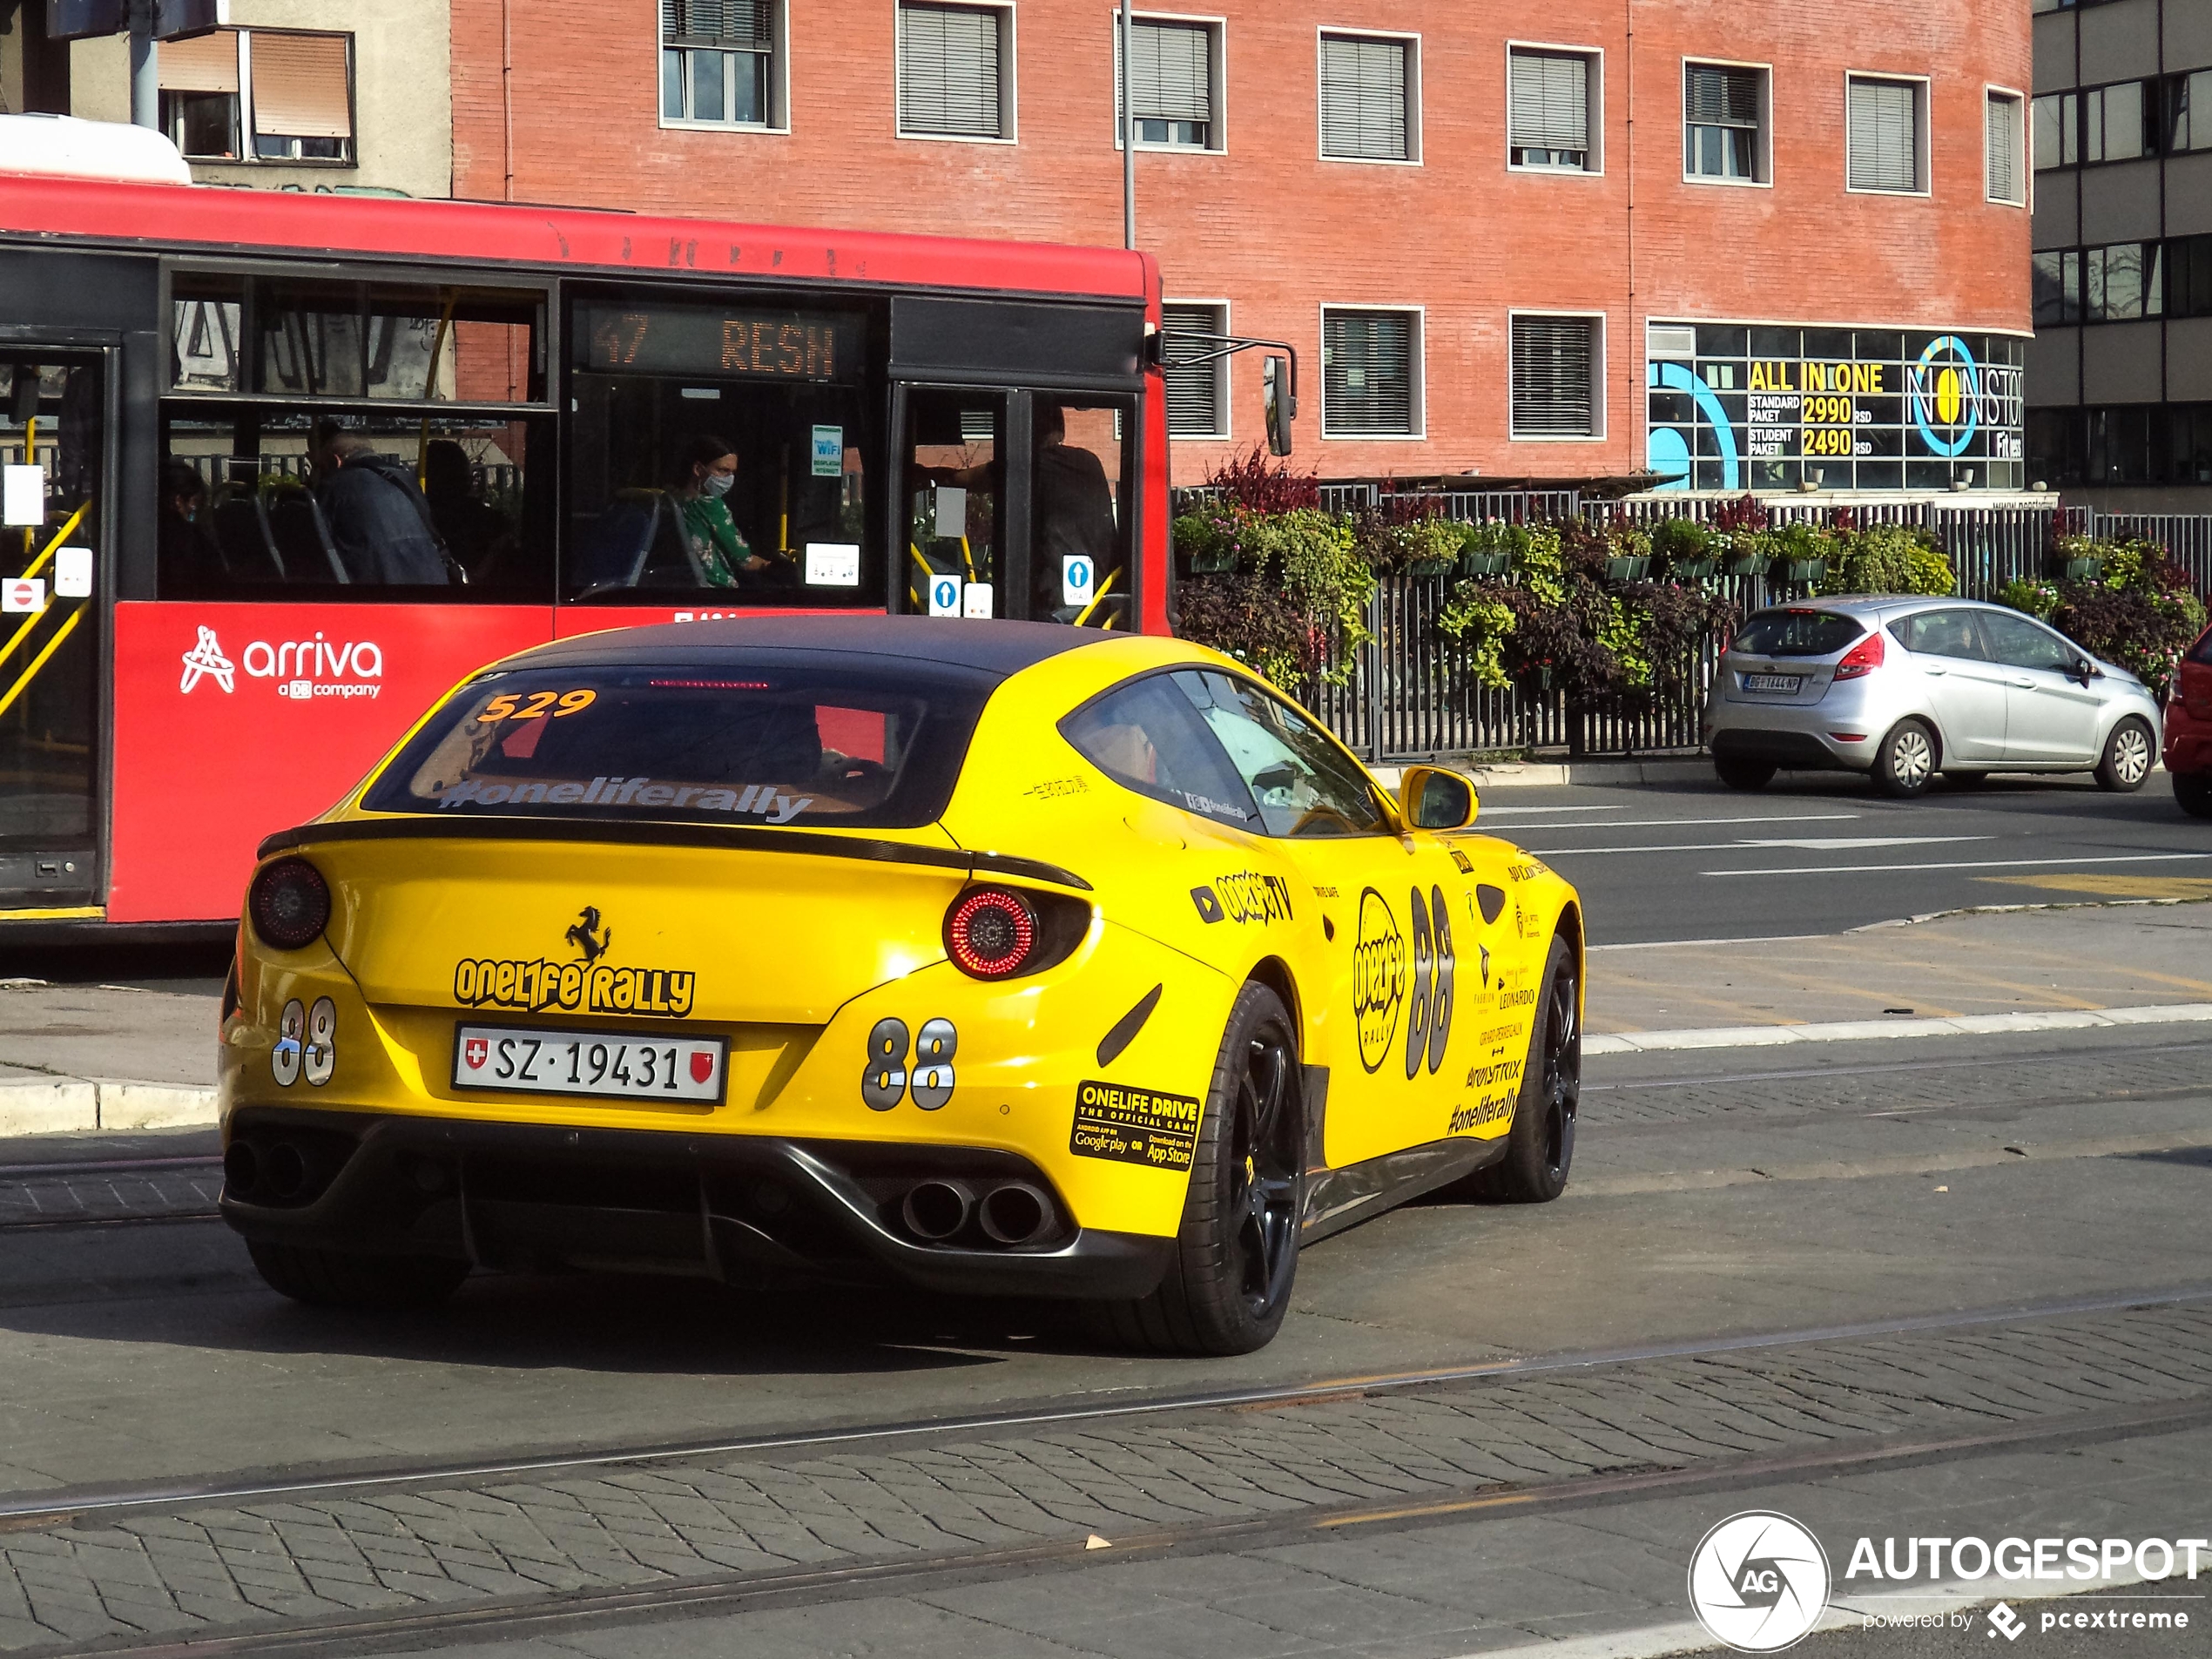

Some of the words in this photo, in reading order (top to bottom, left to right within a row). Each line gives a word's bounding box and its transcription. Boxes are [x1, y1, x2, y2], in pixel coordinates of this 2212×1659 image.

[593, 314, 649, 363] 47
[1750, 361, 1794, 391] ALL
[1803, 361, 1826, 392] IN
[1835, 363, 1884, 393] ONE
[1750, 395, 1800, 409] STANDARD
[1804, 396, 1851, 423] 2990
[1750, 409, 1780, 422] PAKET
[1855, 410, 1872, 423] RSD
[1750, 428, 1793, 442] STUDENT
[1804, 429, 1851, 455] 2490
[1750, 442, 1780, 455] PAKET
[1855, 442, 1872, 455] RSD
[242, 631, 383, 678] arriva
[278, 684, 289, 696] a
[291, 682, 311, 698] DB
[313, 684, 381, 699] company
[476, 688, 597, 723] 529
[438, 777, 813, 823] #oneliferally
[1406, 884, 1455, 1081] 88
[1499, 988, 1535, 1010] LEONARDO
[271, 995, 337, 1088] 88
[1363, 1022, 1393, 1048] RALLY
[860, 1016, 959, 1112] 88
[1082, 1087, 1150, 1114] ONELIFE
[1151, 1096, 1198, 1122] DRIVE
[1447, 1087, 1521, 1136] #oneliferally
[1080, 1106, 1103, 1118] THE
[1110, 1110, 1162, 1127] OFFICIAL
[1167, 1120, 1196, 1133] GAME
[1075, 1132, 1109, 1151] Google
[1109, 1136, 1128, 1154] play
[1131, 1140, 1143, 1151] OR
[1147, 1143, 1167, 1164] App
[1167, 1147, 1191, 1165] Store
